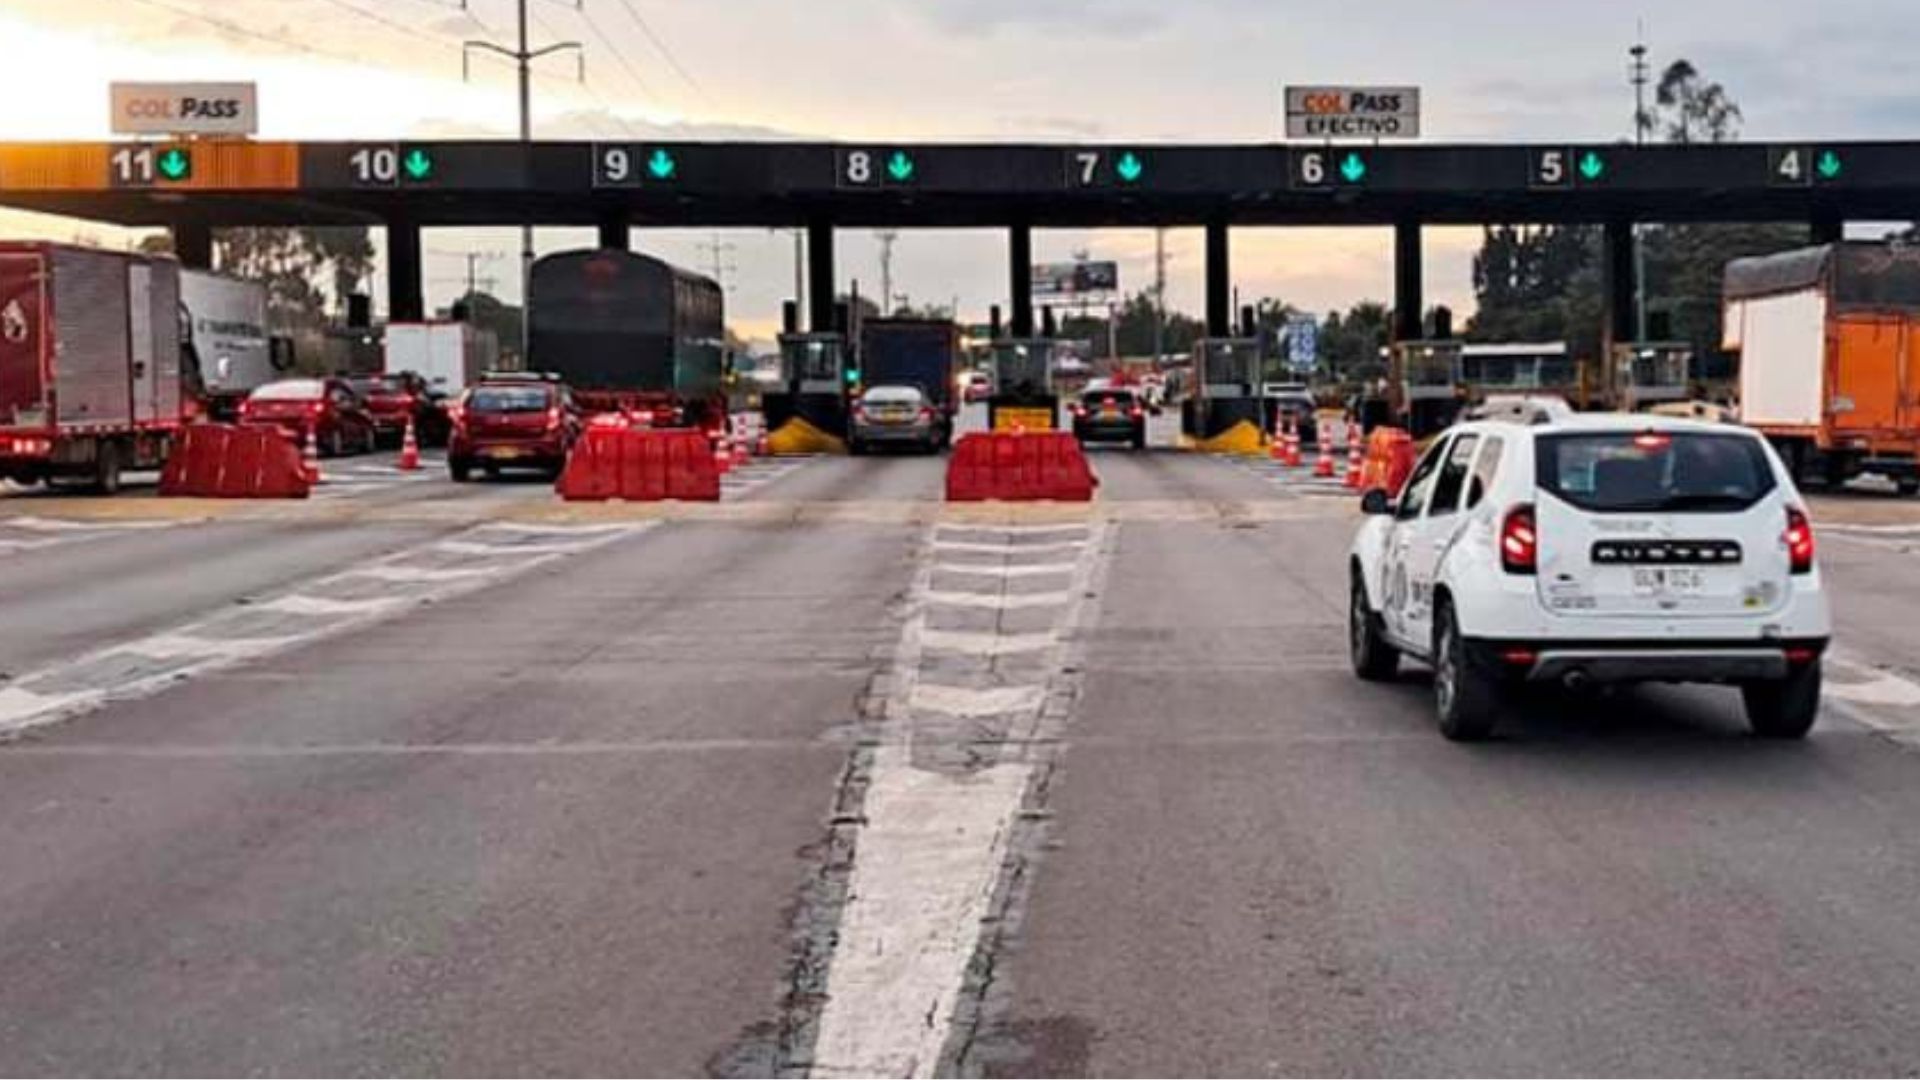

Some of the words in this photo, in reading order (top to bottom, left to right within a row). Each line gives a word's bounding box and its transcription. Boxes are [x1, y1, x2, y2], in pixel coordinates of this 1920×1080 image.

[126, 99, 172, 117] COL
[1304, 92, 1344, 112] COL
[1305, 117, 1401, 135] EFECTIVO
[111, 148, 152, 180] 11
[350, 149, 398, 181] 10
[605, 150, 629, 180] 9
[847, 151, 871, 182] 8
[1077, 152, 1098, 182] 7
[1302, 153, 1324, 182] 6
[1541, 151, 1563, 181] 5
[1779, 150, 1801, 179] 4
